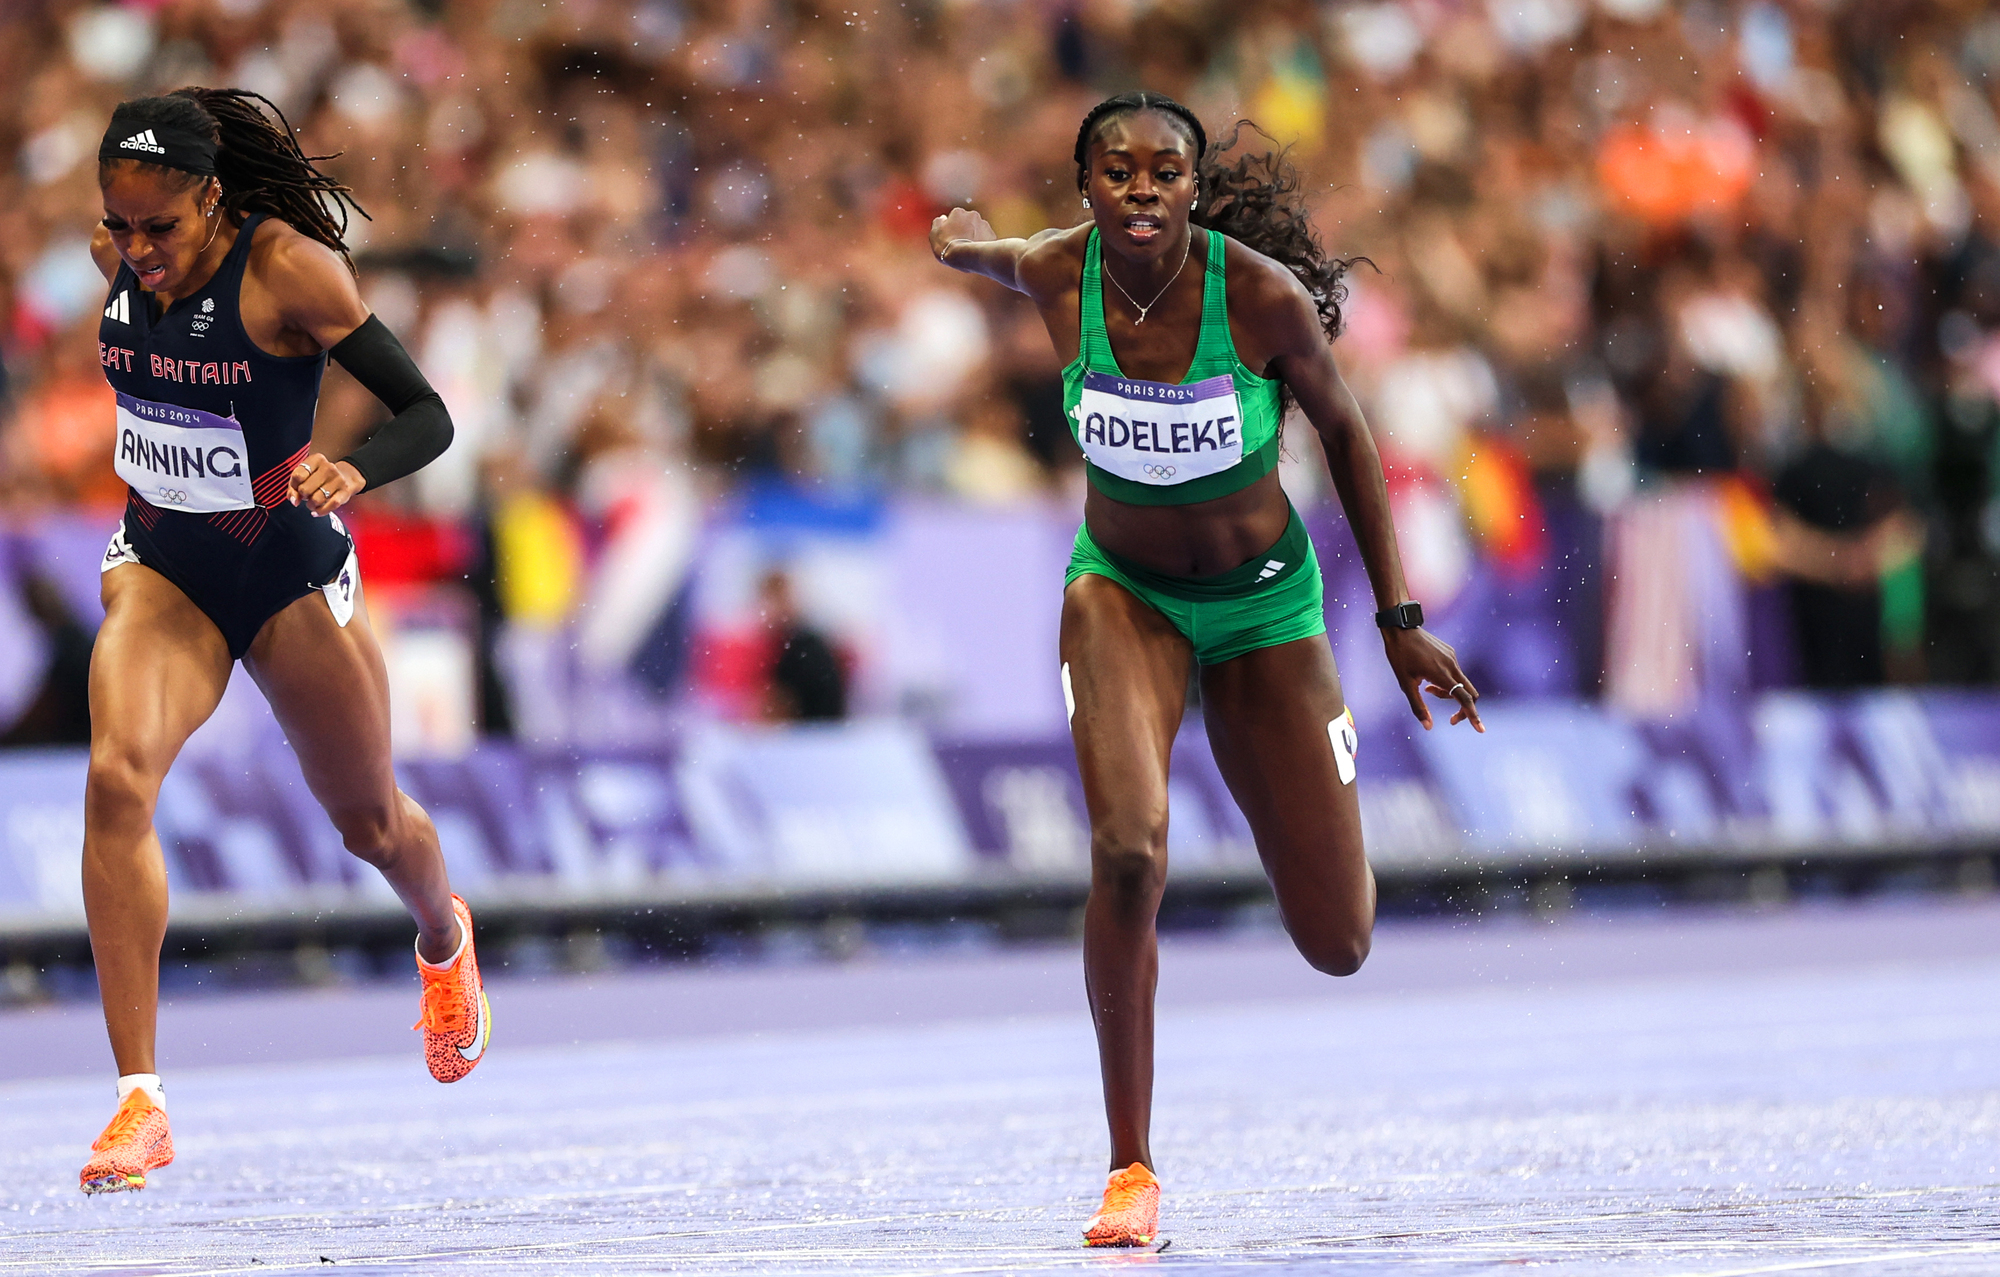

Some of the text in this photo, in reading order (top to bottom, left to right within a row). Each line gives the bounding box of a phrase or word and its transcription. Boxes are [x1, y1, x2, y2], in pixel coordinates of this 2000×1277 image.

[120, 140, 166, 154] adidas
[98, 339, 252, 385] EAT BRITAIN
[1117, 382, 1194, 400] PARIS 2024
[135, 403, 200, 423] PARIS 2024
[1085, 412, 1238, 453] ADELEKE
[121, 428, 242, 478] ANNING
